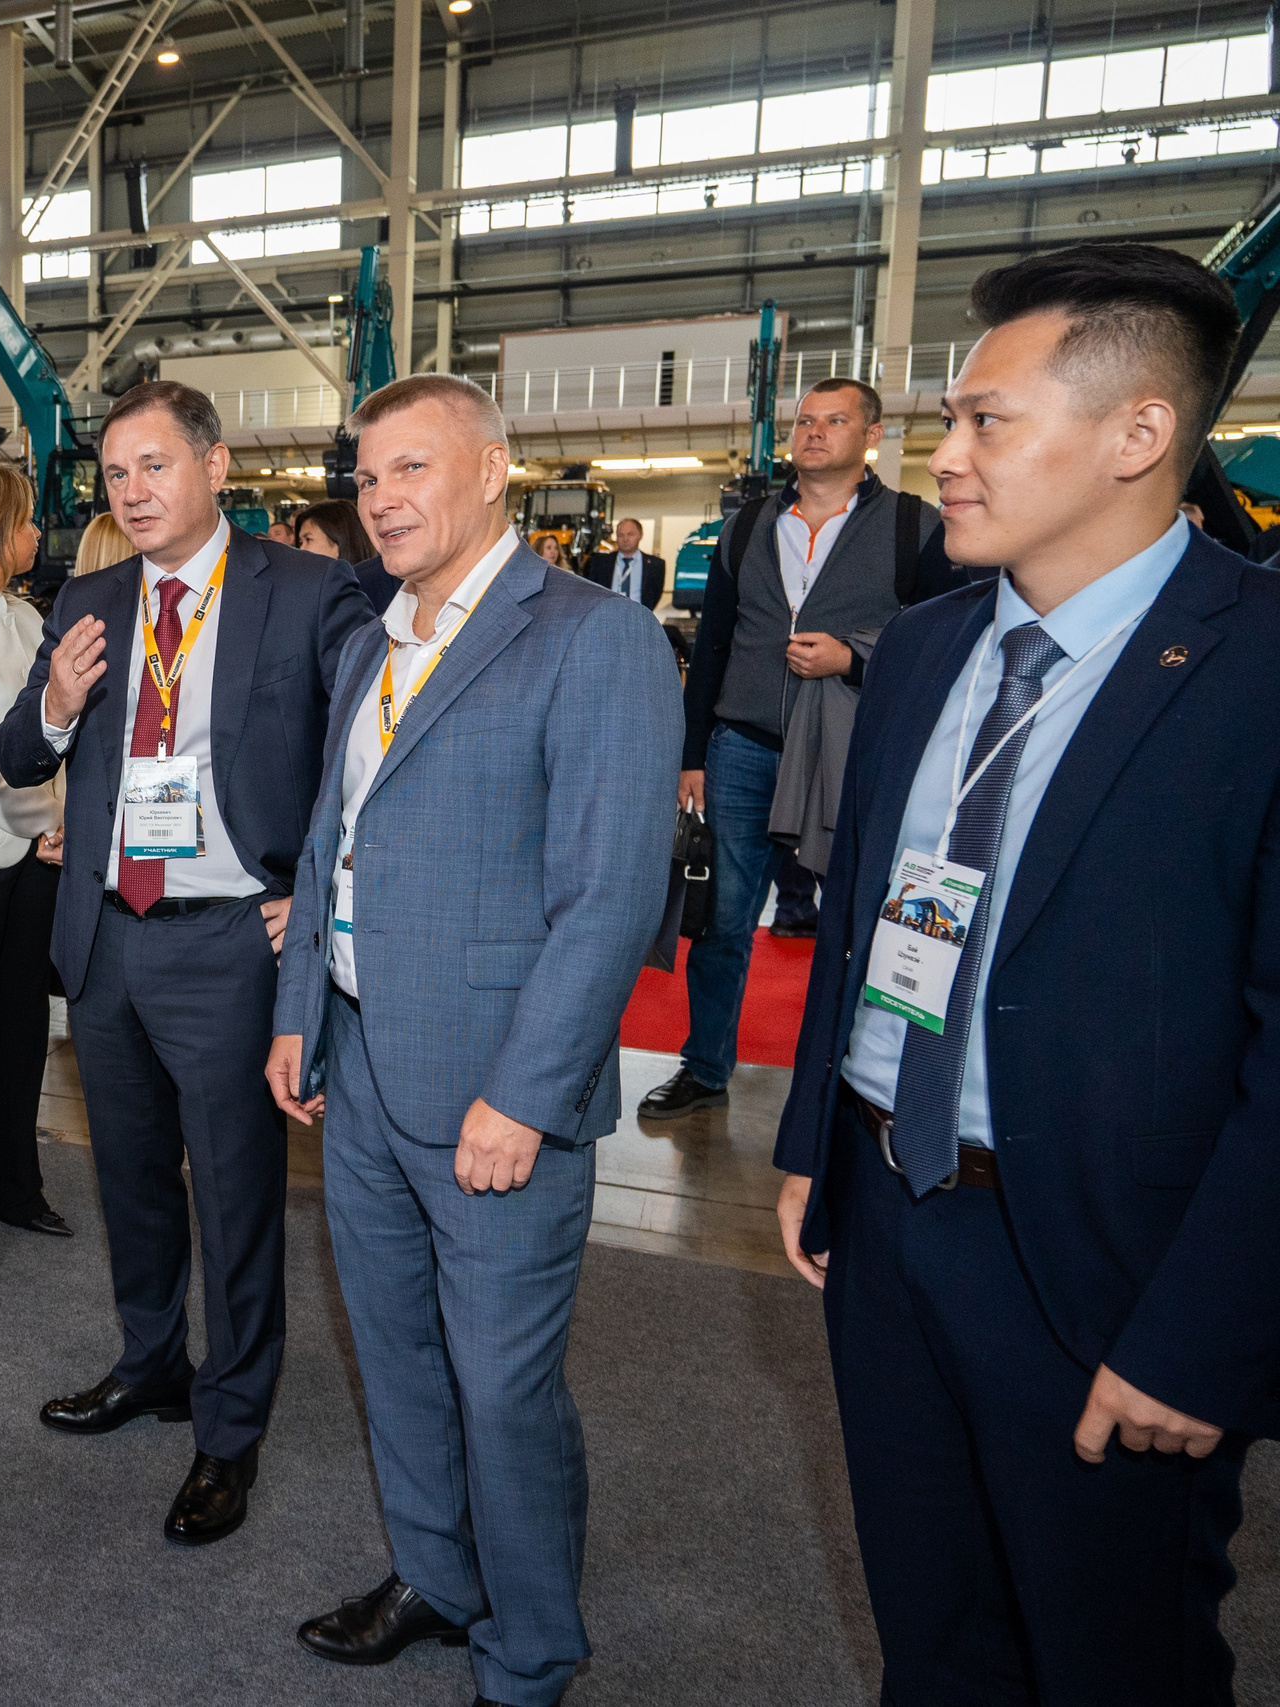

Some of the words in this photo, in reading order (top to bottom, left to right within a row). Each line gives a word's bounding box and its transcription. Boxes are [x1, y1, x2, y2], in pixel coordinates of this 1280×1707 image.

[199, 586, 215, 611] МАШИНЕРИ
[907, 944, 918, 953] Бай
[880, 994, 926, 1020] ПОСЕТИТЕЛЬ
